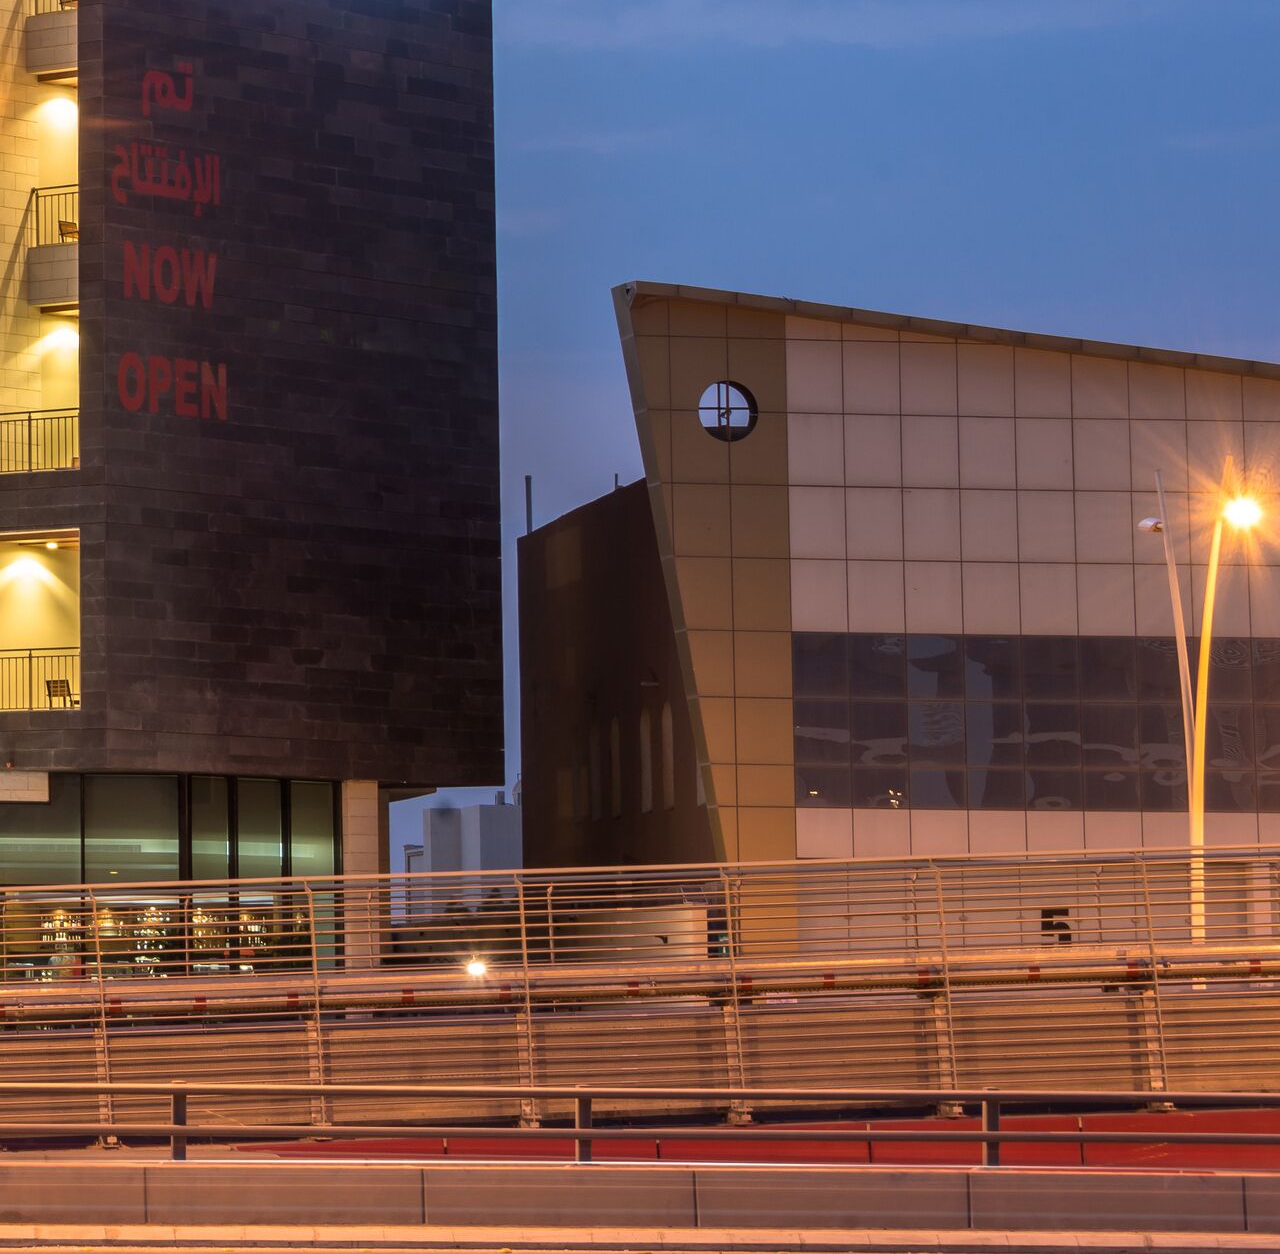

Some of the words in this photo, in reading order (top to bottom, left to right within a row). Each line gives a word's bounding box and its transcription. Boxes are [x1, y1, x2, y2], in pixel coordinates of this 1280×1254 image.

[143, 62, 194, 117] تم
[123, 240, 217, 309] NOW
[117, 352, 228, 420] OPEN
